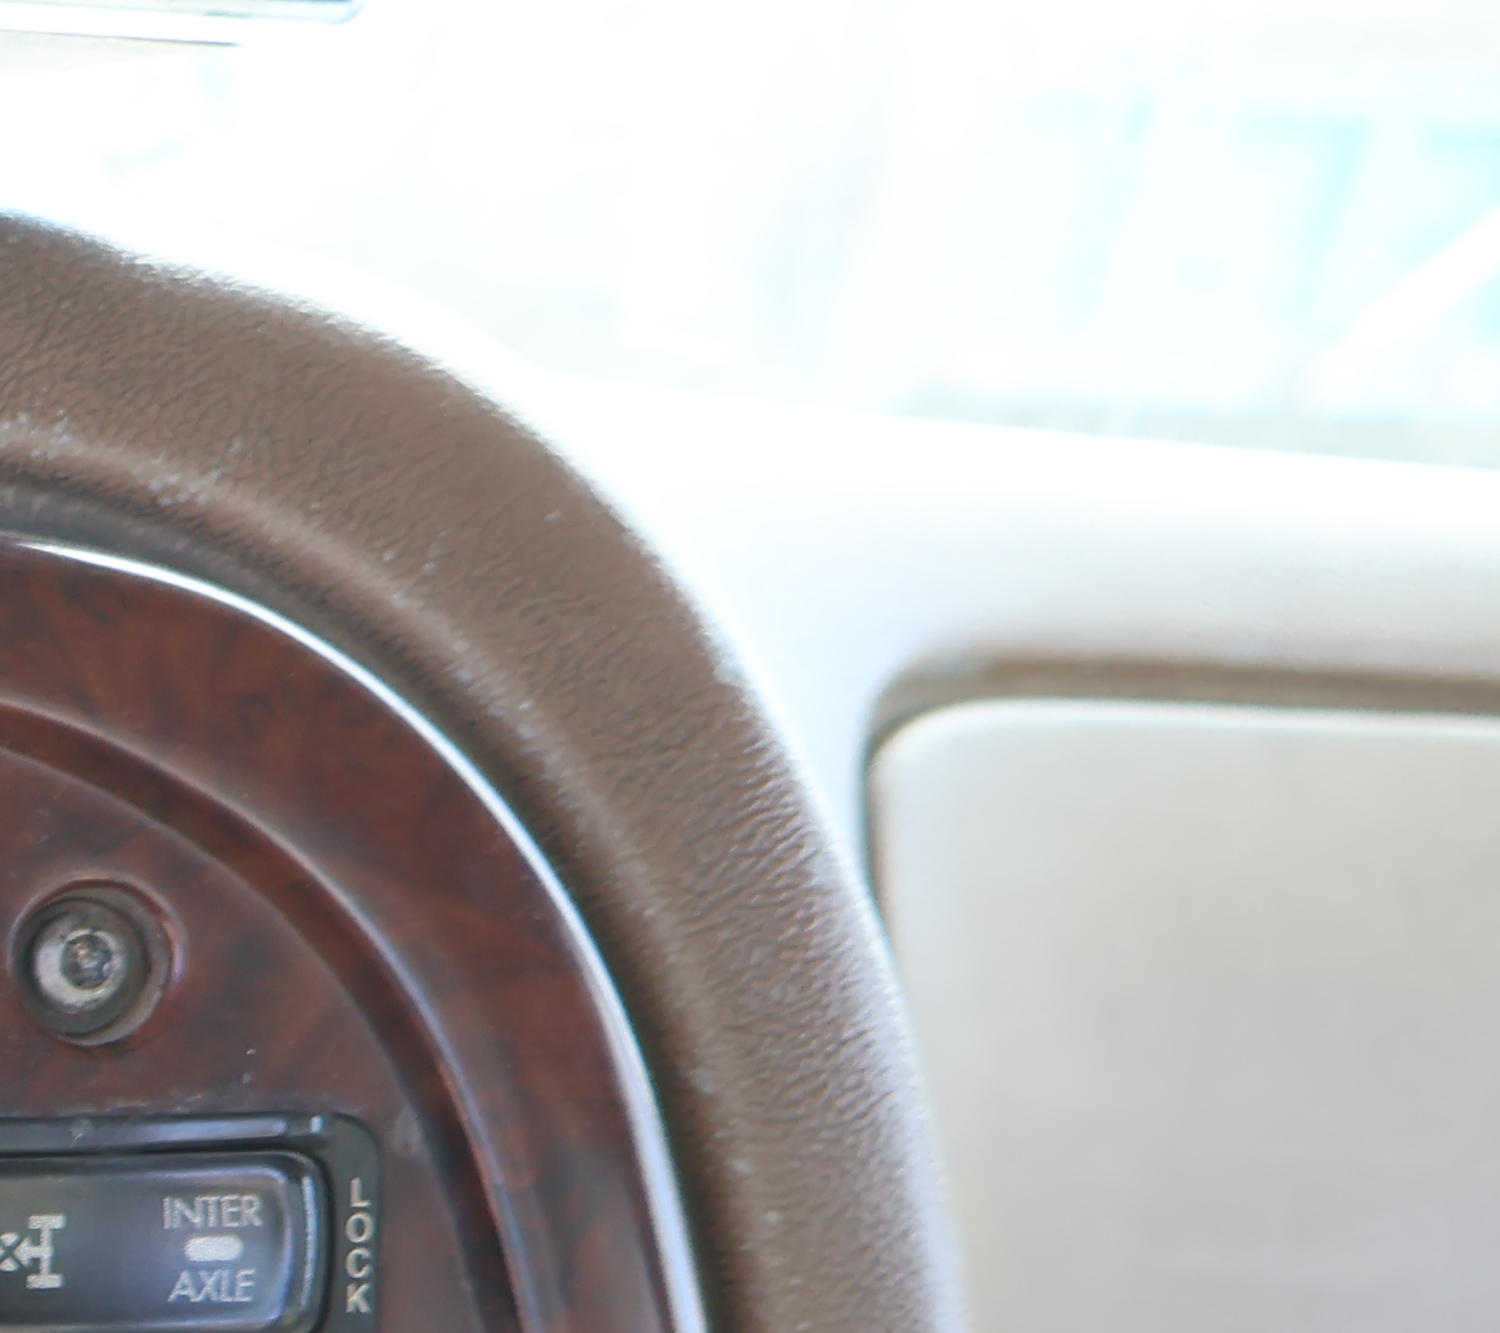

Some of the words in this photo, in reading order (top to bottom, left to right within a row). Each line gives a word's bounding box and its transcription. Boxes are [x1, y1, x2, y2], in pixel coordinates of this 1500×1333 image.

[162, 1195, 263, 1229] INTER
[344, 1179, 375, 1314] LOCK
[167, 1269, 254, 1302] AXLE
